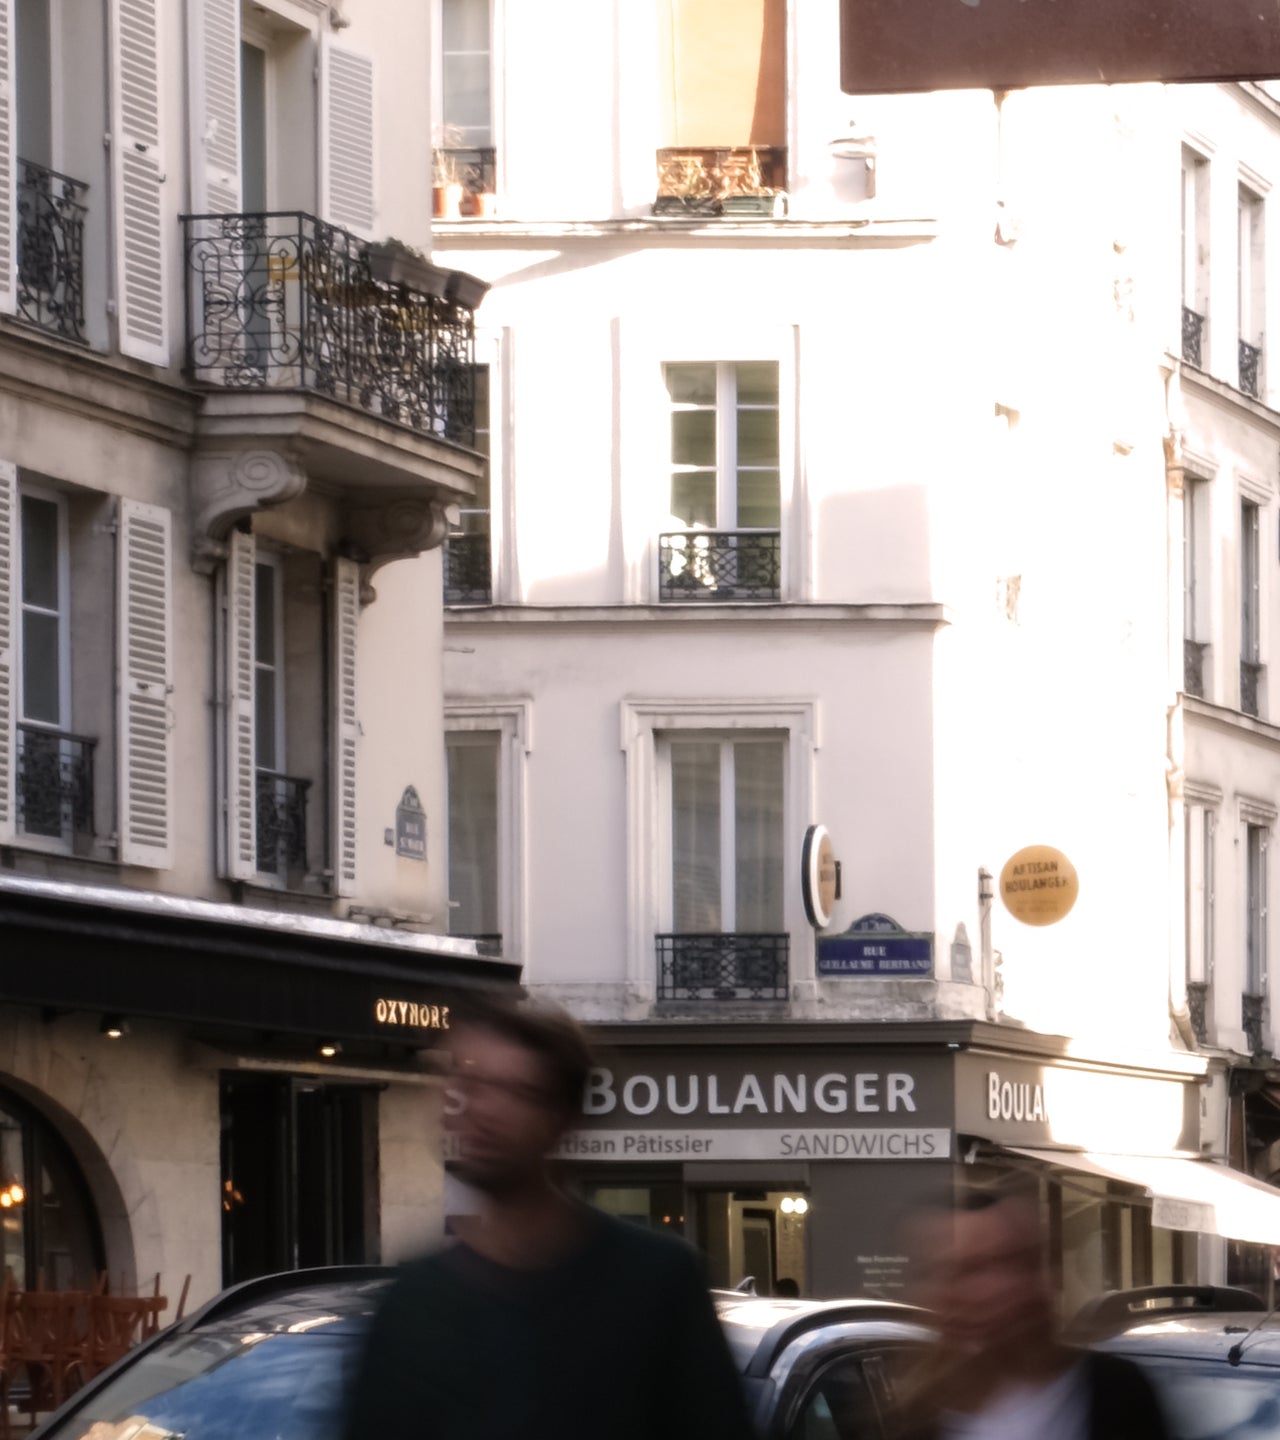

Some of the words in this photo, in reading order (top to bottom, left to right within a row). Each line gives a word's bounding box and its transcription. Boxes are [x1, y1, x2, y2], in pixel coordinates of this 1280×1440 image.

[863, 946, 886, 957] RUE
[582, 1067, 917, 1115] BOULANGER
[623, 1133, 713, 1154] Pâtissier
[779, 1132, 936, 1156] SANDWICHS
